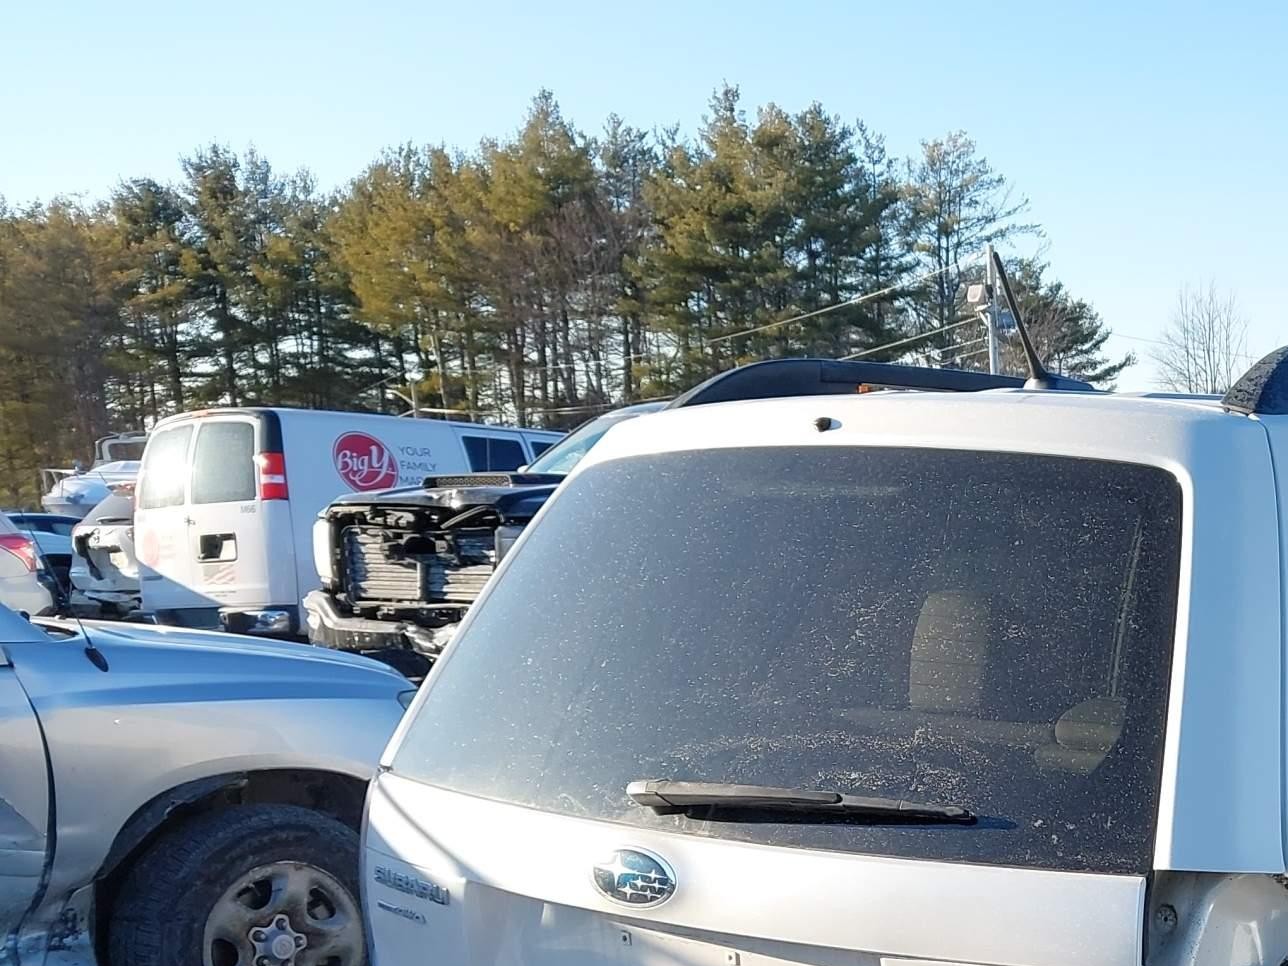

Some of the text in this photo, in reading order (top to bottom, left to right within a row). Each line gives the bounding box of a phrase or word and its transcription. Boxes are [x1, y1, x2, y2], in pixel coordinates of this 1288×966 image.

[399, 446, 432, 457] YOUR
[337, 450, 369, 480] Big
[400, 460, 437, 473] FAMILY
[400, 476, 423, 486] MAR
[374, 865, 450, 905] SUBARU
